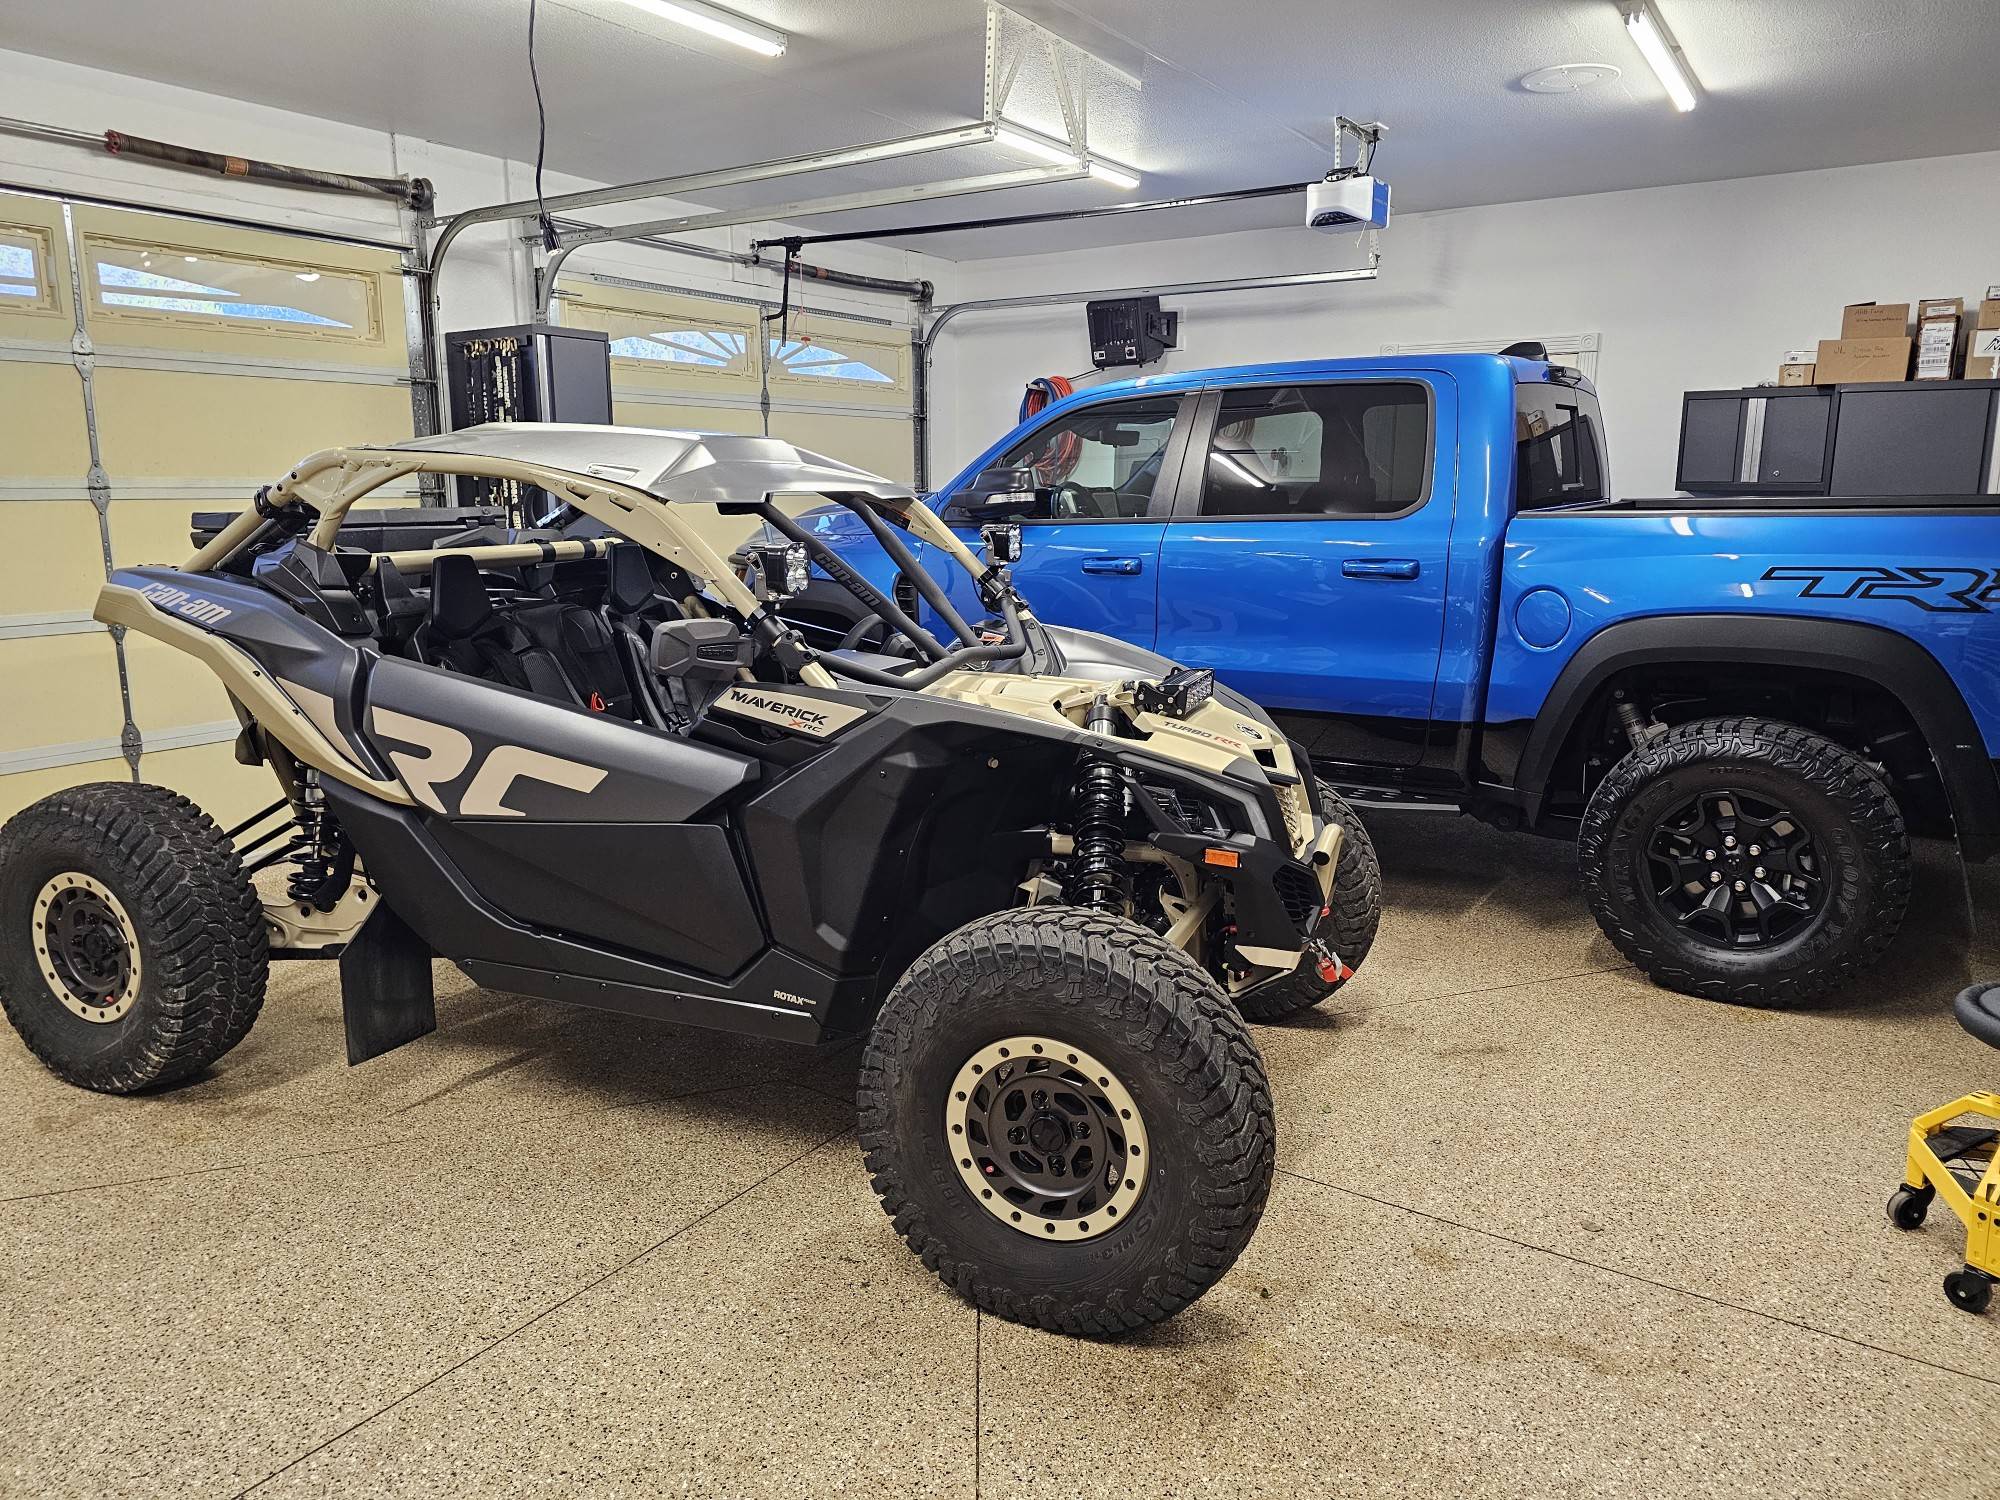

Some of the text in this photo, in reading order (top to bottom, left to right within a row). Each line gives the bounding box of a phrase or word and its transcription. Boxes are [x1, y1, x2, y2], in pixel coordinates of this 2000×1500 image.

[815, 552, 881, 607] can-am
[140, 582, 232, 625] can-am
[730, 690, 829, 726] MAVERICK
[1164, 721, 1242, 749] TURBO RR
[371, 706, 609, 817] RC
[773, 989, 804, 1005] ROTAX
